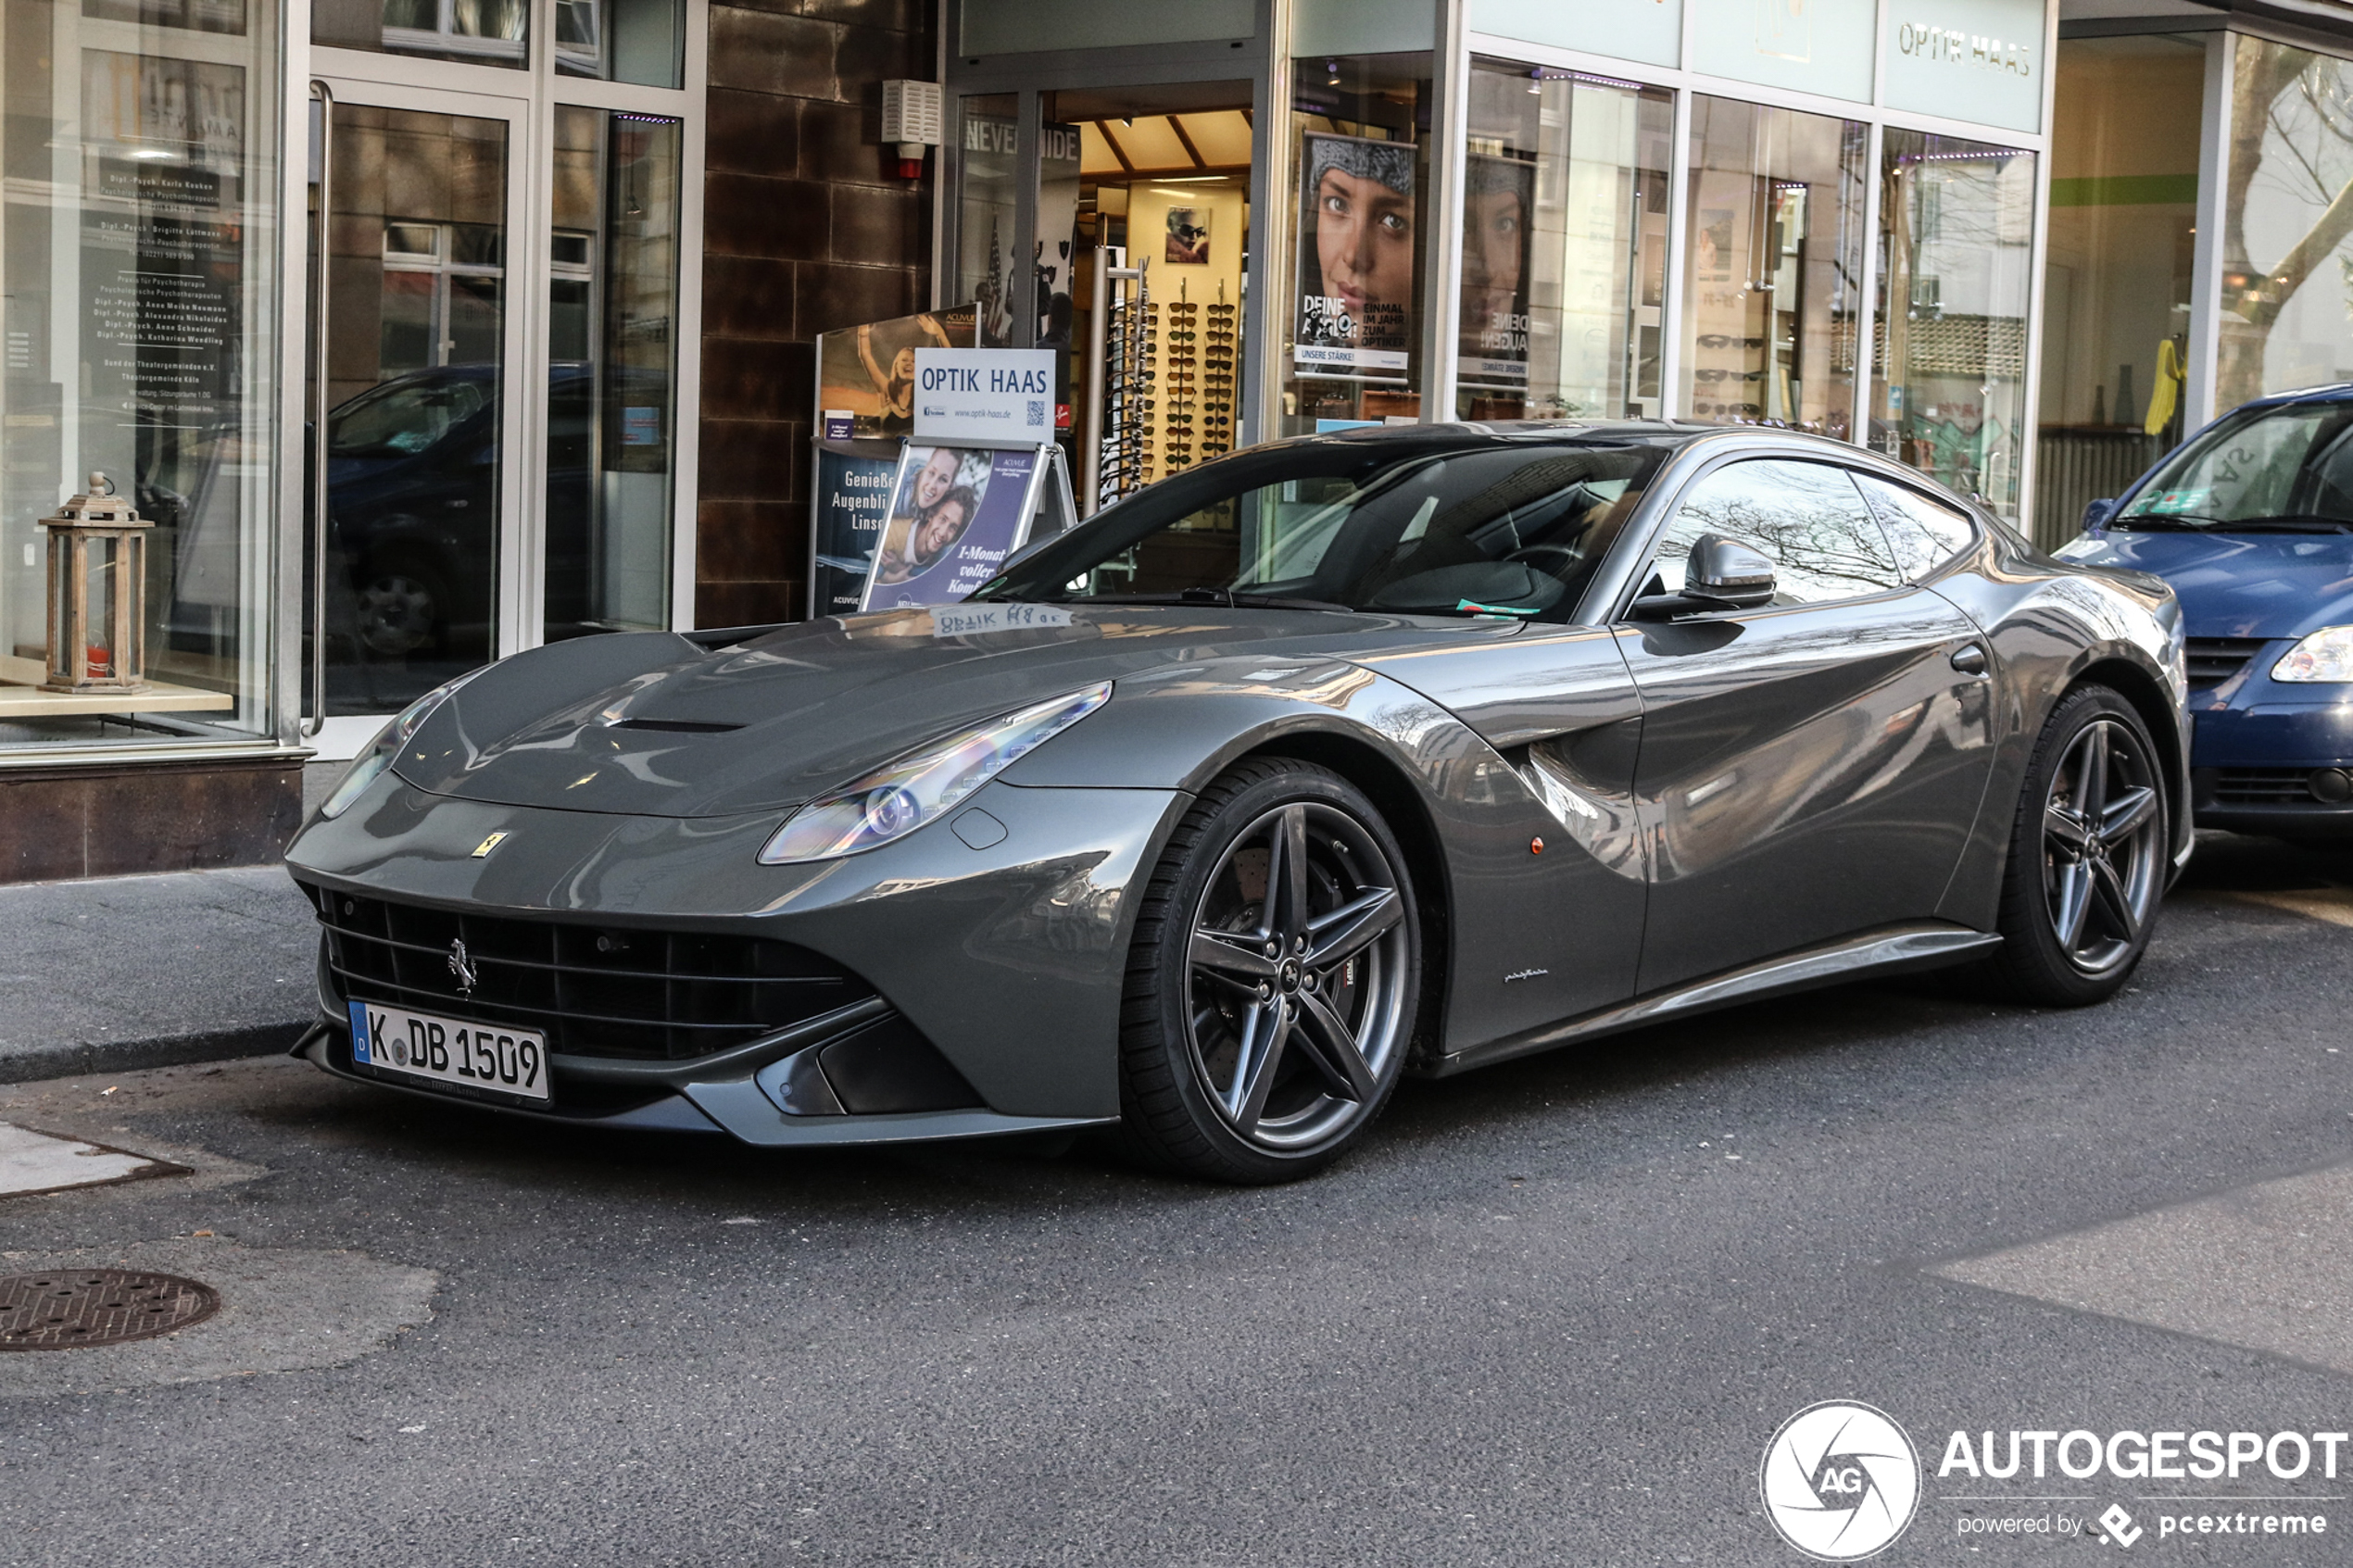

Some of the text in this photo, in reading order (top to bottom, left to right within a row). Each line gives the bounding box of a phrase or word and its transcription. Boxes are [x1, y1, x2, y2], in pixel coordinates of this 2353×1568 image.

[1899, 21, 2030, 77] OPTIK HAAS
[966, 119, 1018, 155] NEVE
[1302, 295, 1346, 316] DEINE
[1364, 303, 1404, 314] EINMAL
[1363, 313, 1404, 325] IM JAHR
[1362, 325, 1387, 336] ZUM
[1361, 336, 1406, 348] OPTIKER
[1301, 348, 1355, 362] UNSERE STÄRKE!
[121, 373, 200, 383] Theatergemeinde Köln
[922, 367, 1047, 394] OPTIK HAAS
[954, 409, 1012, 419] www.optik-haas.de
[845, 470, 895, 488] Genieße
[957, 545, 1007, 562] 1-Monat
[959, 563, 995, 578] voller
[358, 1037, 366, 1051] D
[369, 1010, 539, 1088] K DB 1509
